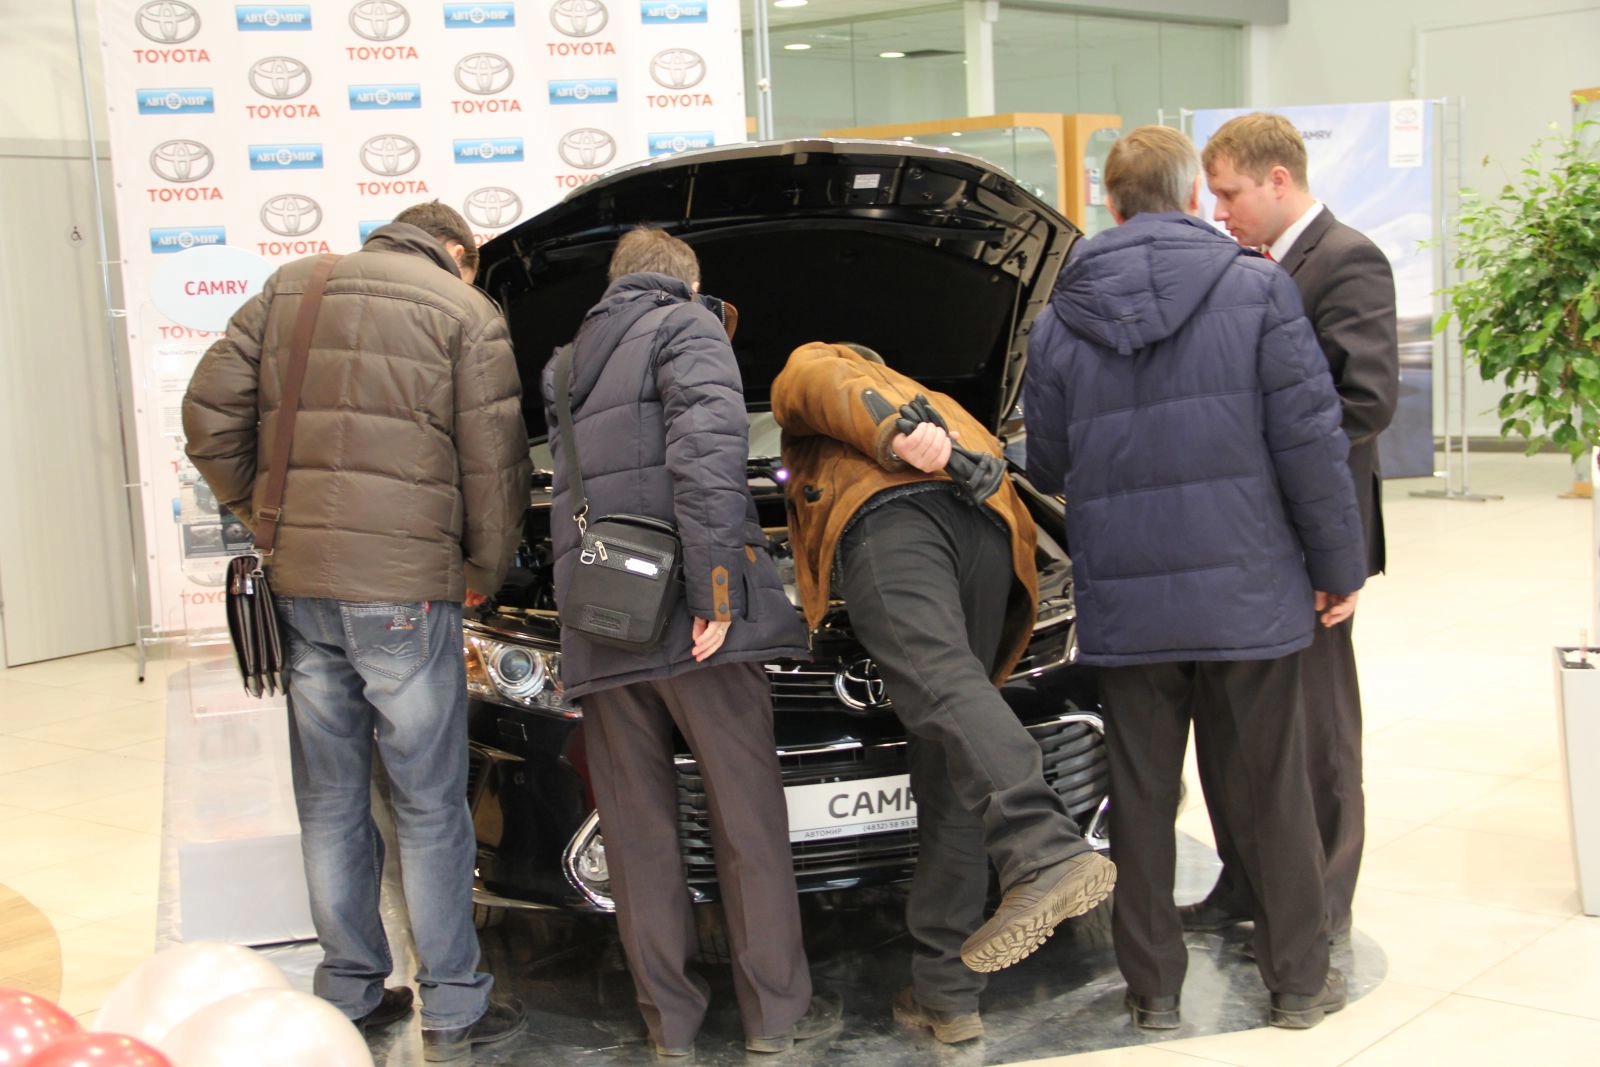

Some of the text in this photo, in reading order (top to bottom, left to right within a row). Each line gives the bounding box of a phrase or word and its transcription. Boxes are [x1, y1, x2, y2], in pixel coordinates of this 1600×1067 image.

[133, 49, 210, 63] TOYOTA
[346, 46, 419, 61] TOYOTA
[546, 42, 616, 57] TOYOTA
[451, 99, 522, 114] TOYOTA
[646, 94, 713, 109] TOYOTA
[246, 104, 320, 119] TOYOTA
[1303, 130, 1332, 140] AMRY
[147, 187, 223, 202] TOYOTA
[357, 180, 429, 196] TOYOTA
[257, 240, 331, 256] TOYOTA
[184, 280, 248, 296] CAMRY
